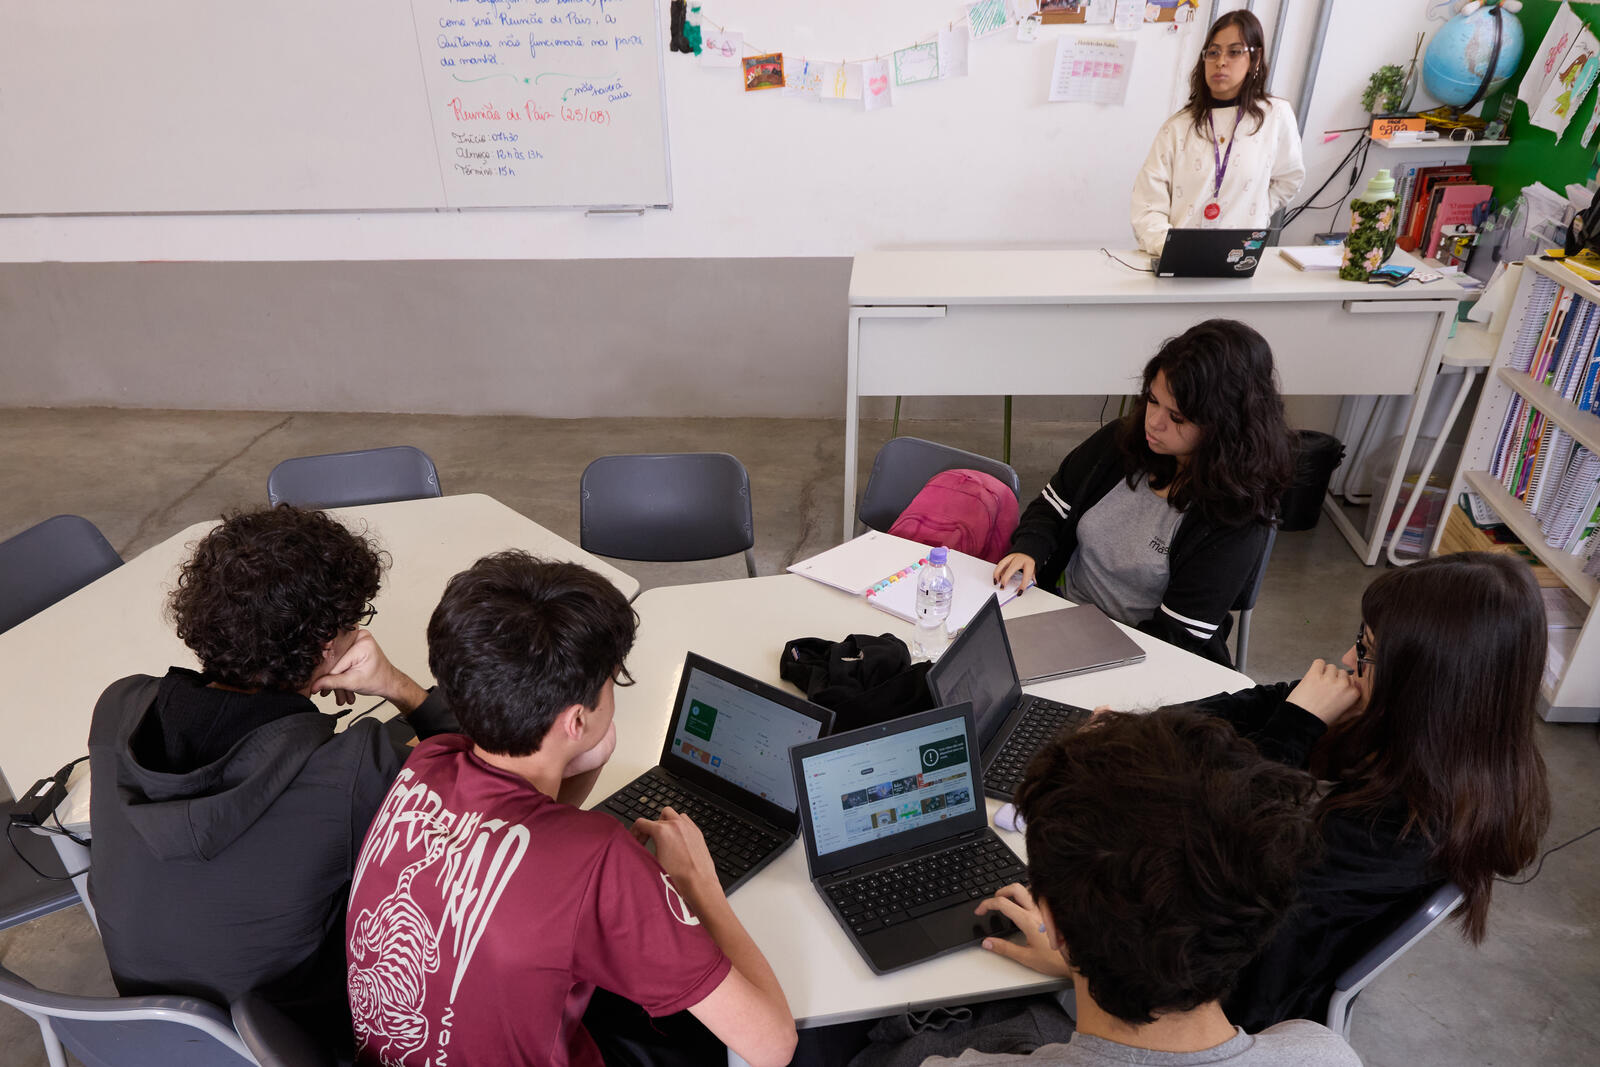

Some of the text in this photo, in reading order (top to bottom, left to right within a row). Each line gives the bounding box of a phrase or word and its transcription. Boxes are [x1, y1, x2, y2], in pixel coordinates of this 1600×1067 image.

[499, 12, 543, 25] Reunião
[550, 15, 562, 24] de
[499, 34, 521, 47] não
[591, 39, 608, 47] na
[574, 82, 594, 96] não
[607, 91, 633, 103] aula
[448, 97, 501, 121] Reunião
[506, 107, 521, 121] de
[524, 99, 556, 121] Pais
